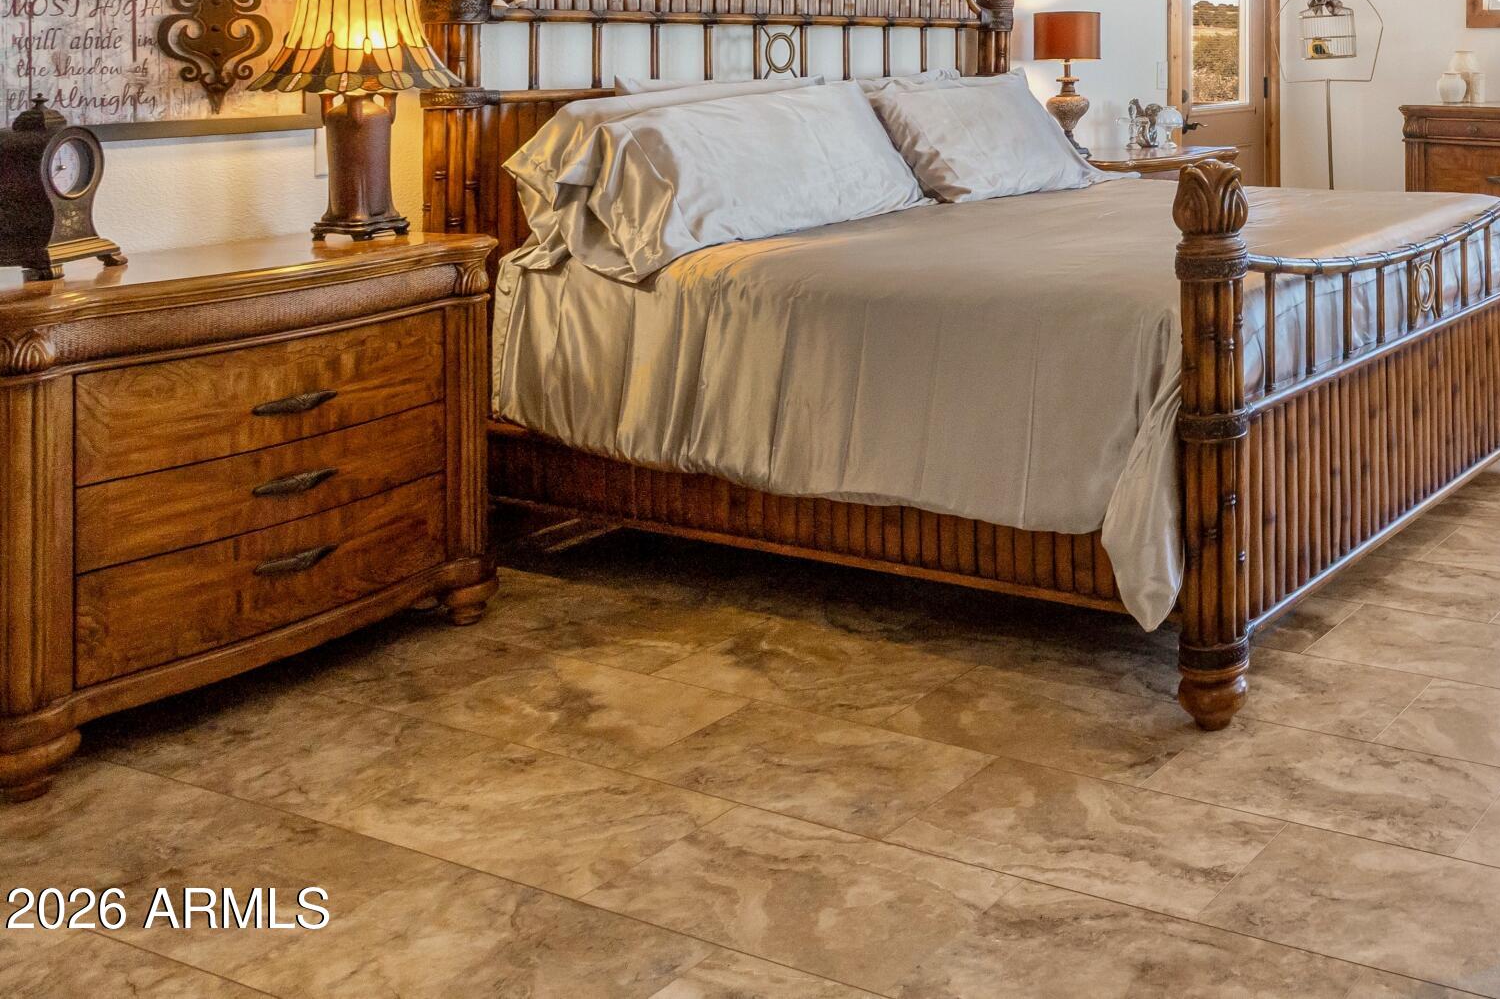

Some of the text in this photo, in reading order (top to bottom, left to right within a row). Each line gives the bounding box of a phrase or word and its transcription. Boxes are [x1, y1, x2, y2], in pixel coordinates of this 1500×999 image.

[13, 27, 158, 50] will abide in
[17, 54, 149, 78] the shadow of
[7, 82, 156, 116] th Almighty
